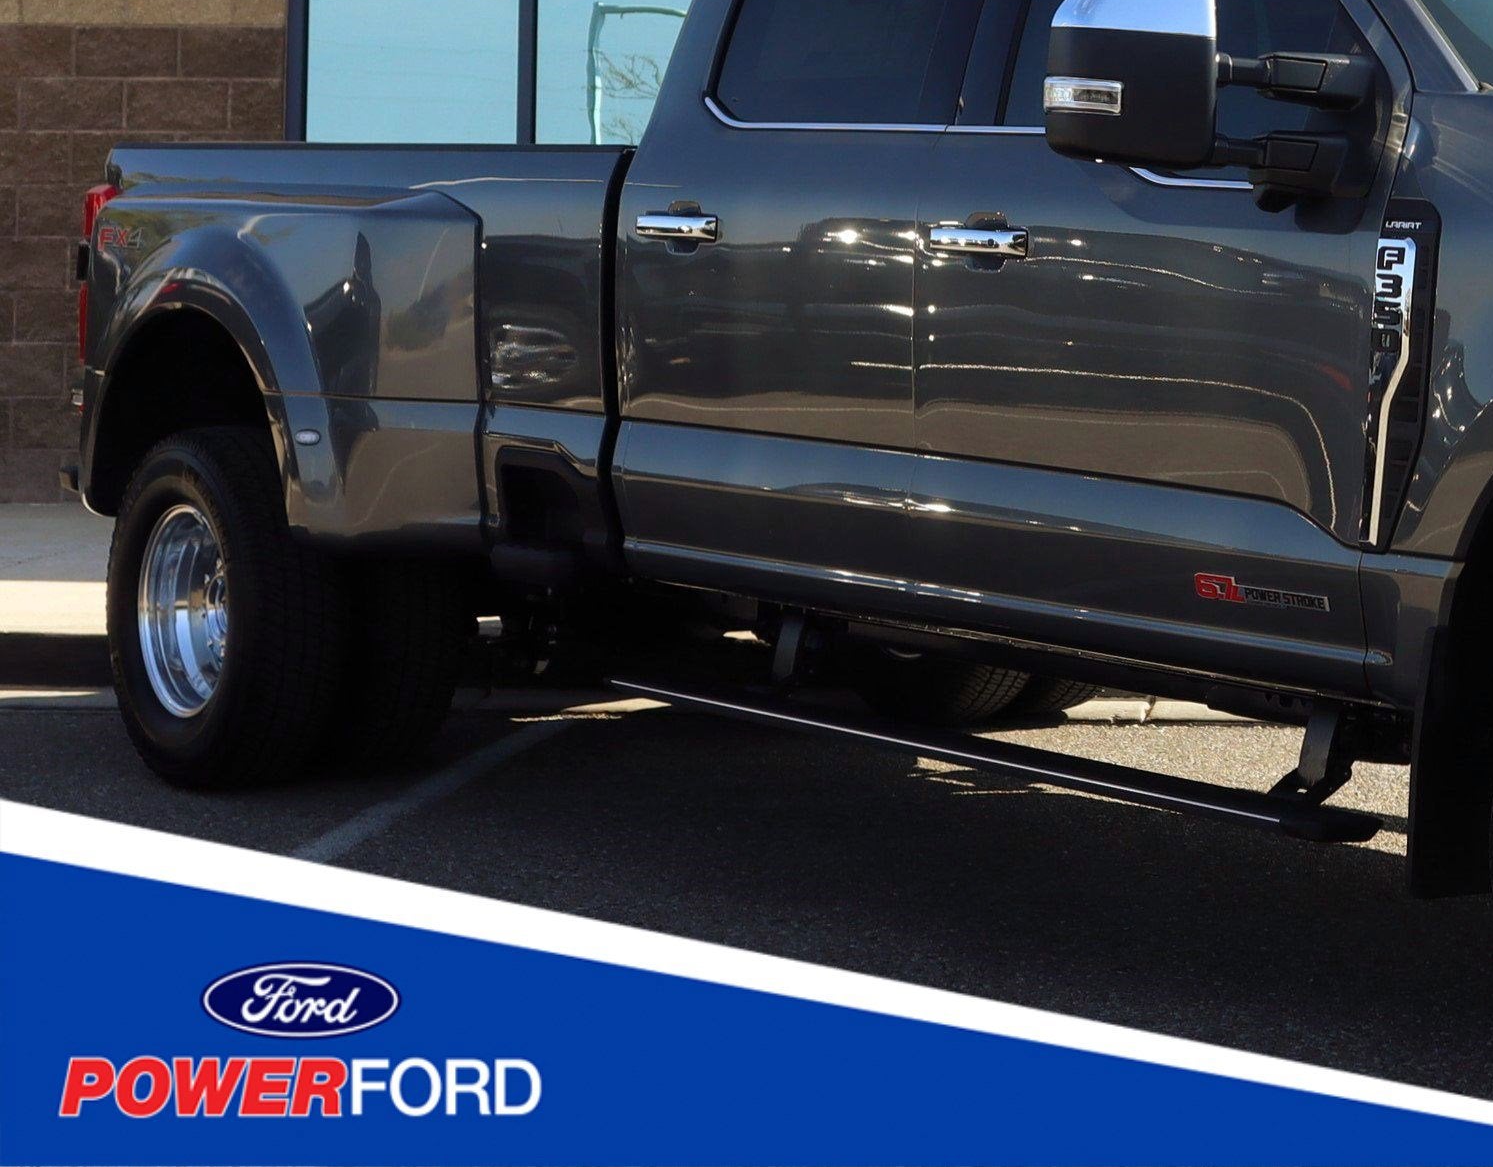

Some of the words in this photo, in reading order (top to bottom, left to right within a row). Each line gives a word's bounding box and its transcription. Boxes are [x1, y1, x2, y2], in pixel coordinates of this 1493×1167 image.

[1385, 221, 1424, 230] LARIAT
[97, 227, 145, 252] FX4
[1245, 586, 1281, 605] POWER
[1282, 593, 1326, 610] STROKE
